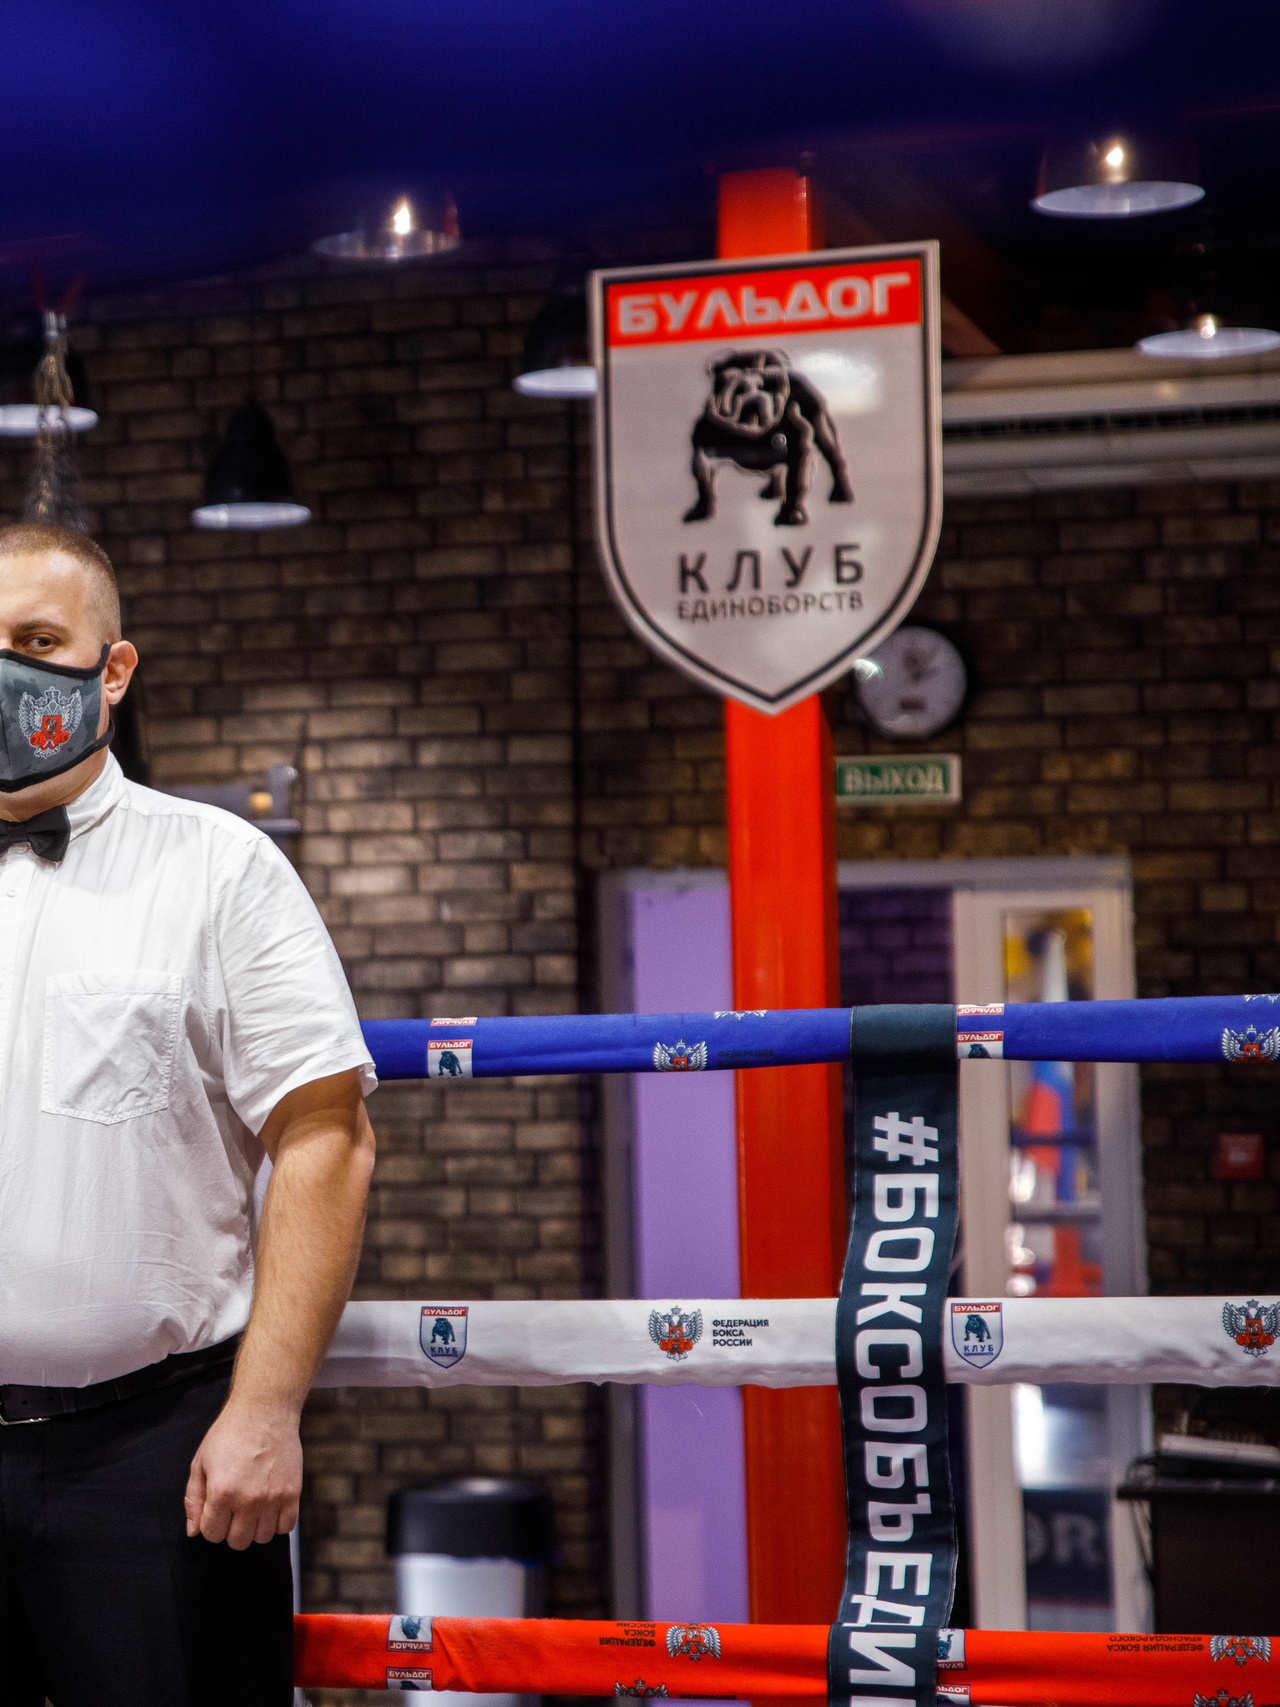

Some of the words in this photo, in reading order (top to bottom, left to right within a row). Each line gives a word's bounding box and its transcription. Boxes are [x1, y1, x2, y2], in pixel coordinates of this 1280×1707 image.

[619, 272, 911, 335] БУЛЬДОГ
[677, 543, 864, 594] КЛУБ
[677, 591, 864, 623] ЕДИНОБОРСТВ
[844, 765, 946, 793] ВЫХОД
[958, 1033, 1002, 1041] БУЛЬДОГ
[429, 1041, 471, 1049] БУЛЬДОГ
[712, 1319, 770, 1328] ФЕДЕРАЦИЯ
[712, 1329, 745, 1337] БОКСА
[712, 1338, 753, 1346] РОССИИ
[430, 1346, 458, 1354] КЛУБ
[963, 1344, 994, 1352] КЛУБ
[624, 1629, 656, 1637] БОКСА
[390, 1642, 431, 1650] БУЛЬДОГ
[599, 1637, 656, 1647] ФЕДЕРАЦИЯ
[1144, 1644, 1205, 1652] ФЕДЕРАЦИЯ
[388, 1670, 430, 1678] БУЛЬДОГ
